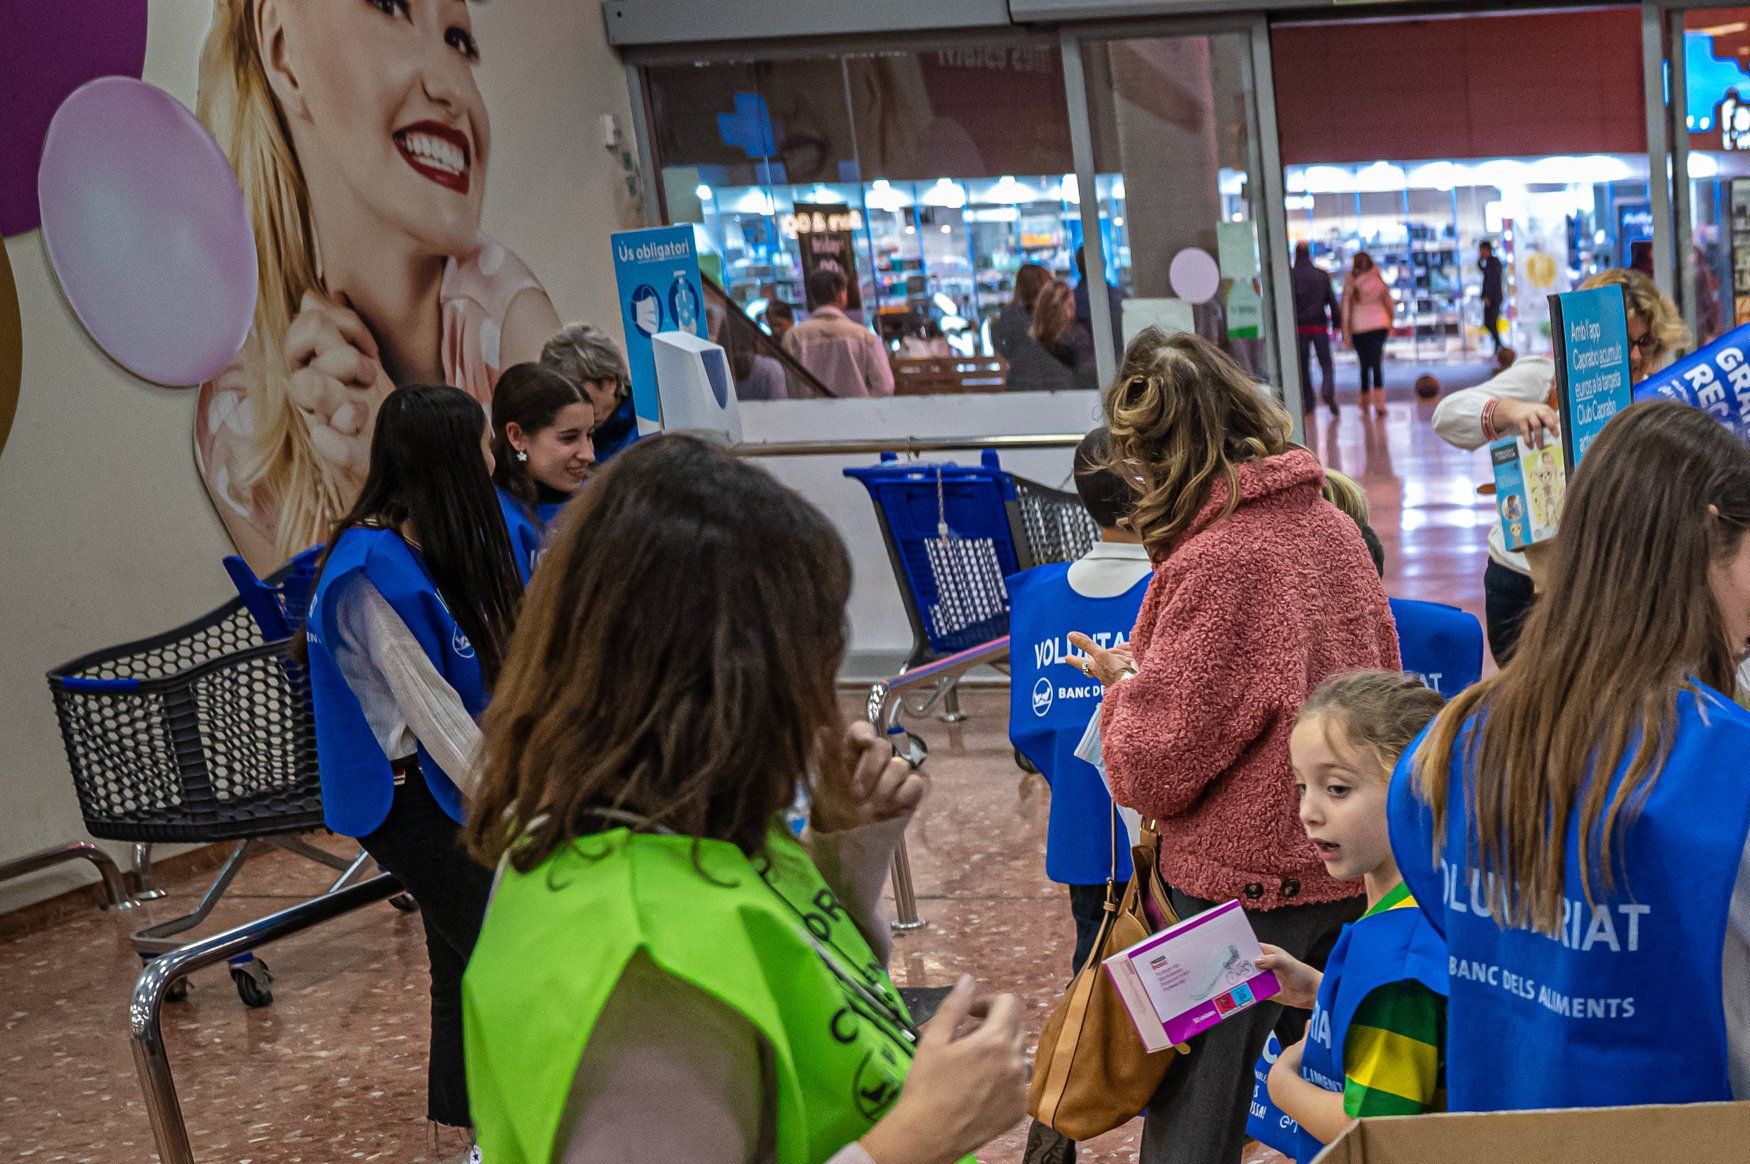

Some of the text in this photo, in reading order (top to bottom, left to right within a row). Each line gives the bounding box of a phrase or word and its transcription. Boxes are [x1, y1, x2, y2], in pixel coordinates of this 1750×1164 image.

[636, 239, 690, 262] obligatori
[1058, 686, 1091, 700] BANC
[1448, 954, 1636, 1019] BANC DELS ALIMENTS
